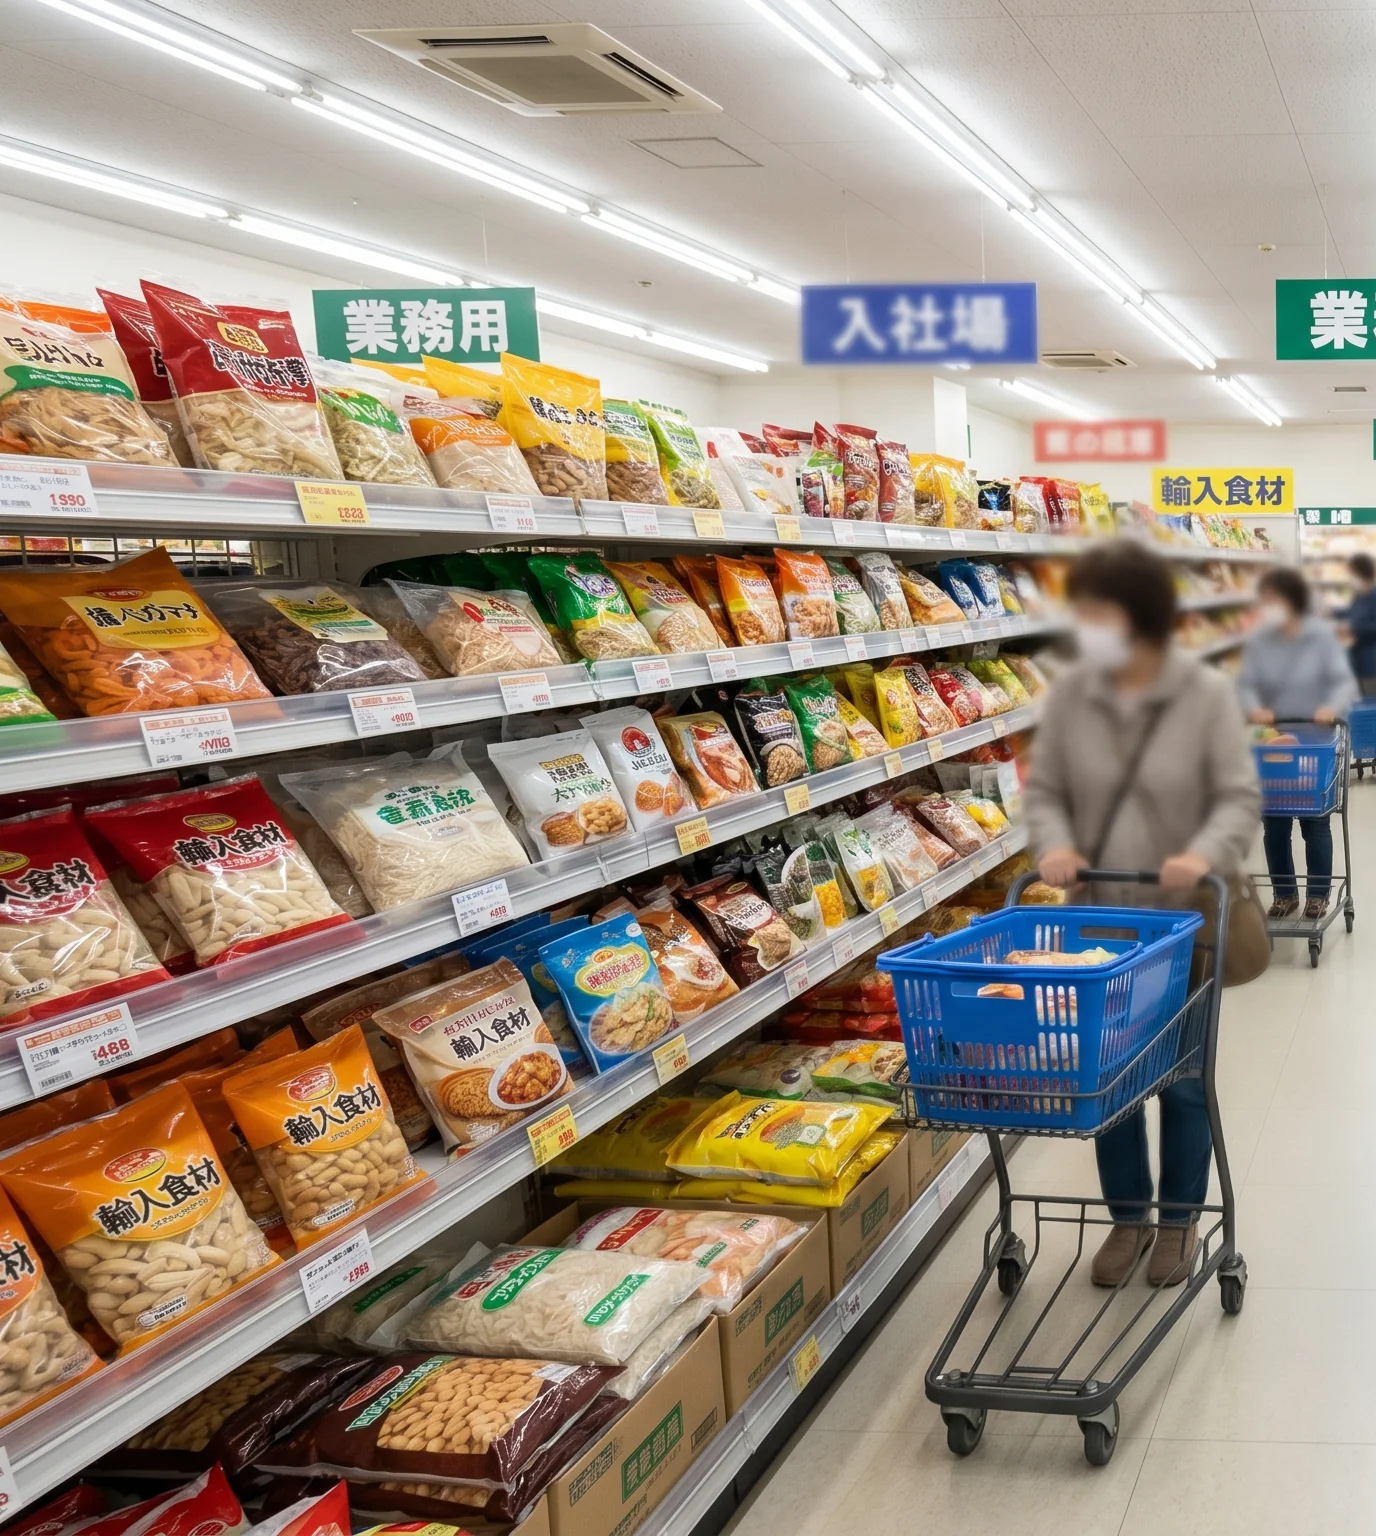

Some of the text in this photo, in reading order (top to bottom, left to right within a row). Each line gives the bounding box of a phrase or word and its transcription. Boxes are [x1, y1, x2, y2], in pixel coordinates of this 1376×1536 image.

[344, 299, 508, 355] 業務用
[1161, 475, 1285, 505] 輸入食材
[174, 821, 287, 866] 輸入食材
[450, 1007, 531, 1060] 輸入食材
[284, 1082, 381, 1145] 輸入食材
[96, 1157, 220, 1235] 輸入食材
